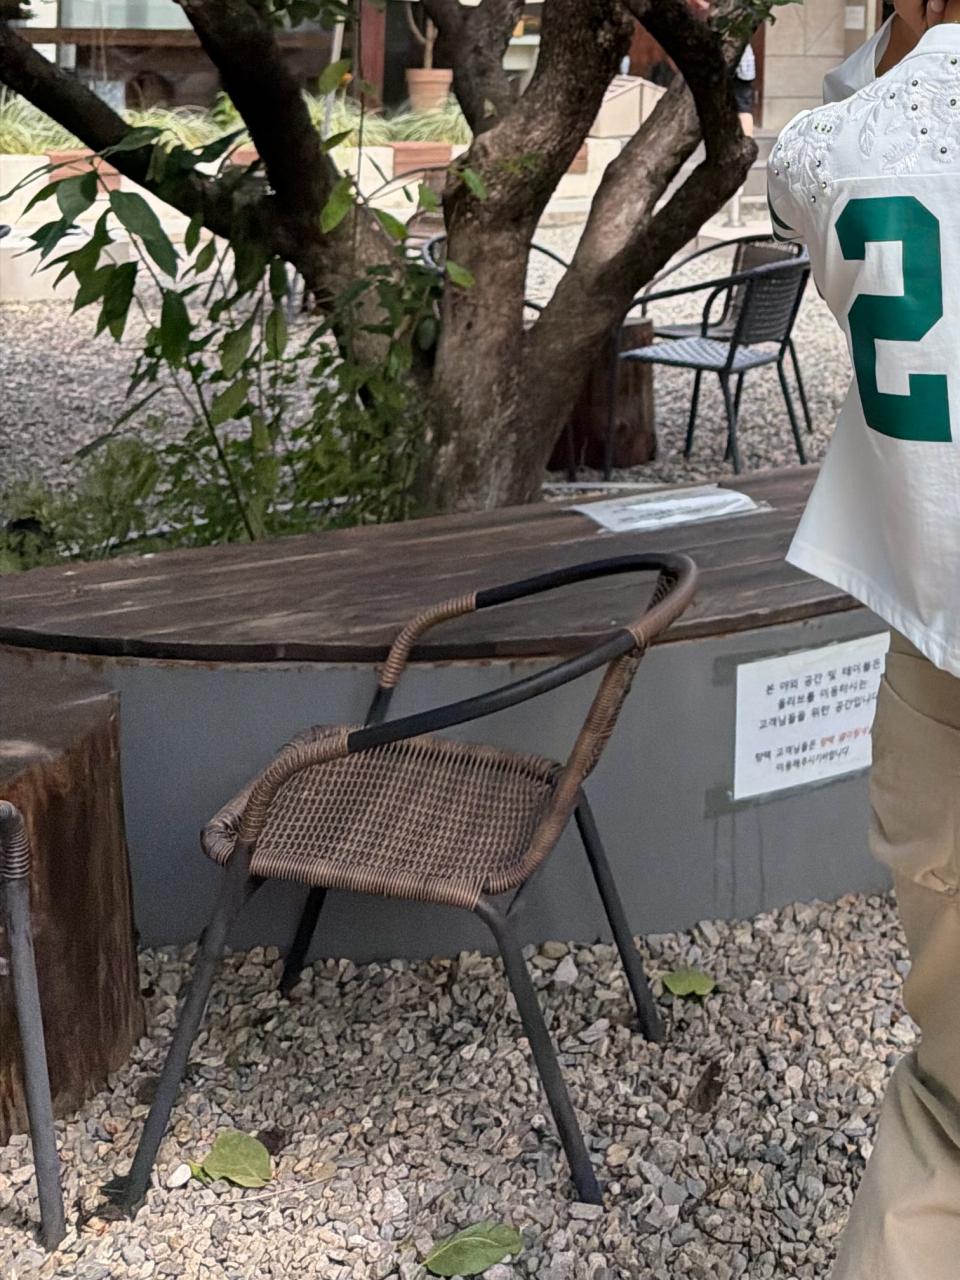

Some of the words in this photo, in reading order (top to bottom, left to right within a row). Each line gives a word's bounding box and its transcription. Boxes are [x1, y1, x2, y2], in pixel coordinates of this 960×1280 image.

[766, 683, 775, 695] 본
[779, 678, 799, 691] 야외
[804, 673, 823, 687] 공간
[827, 669, 837, 680] 및
[841, 658, 881, 676] 테이블은
[820, 679, 868, 698] 이용하시는
[759, 710, 806, 730] 고객님들을
[811, 704, 830, 717] 위한
